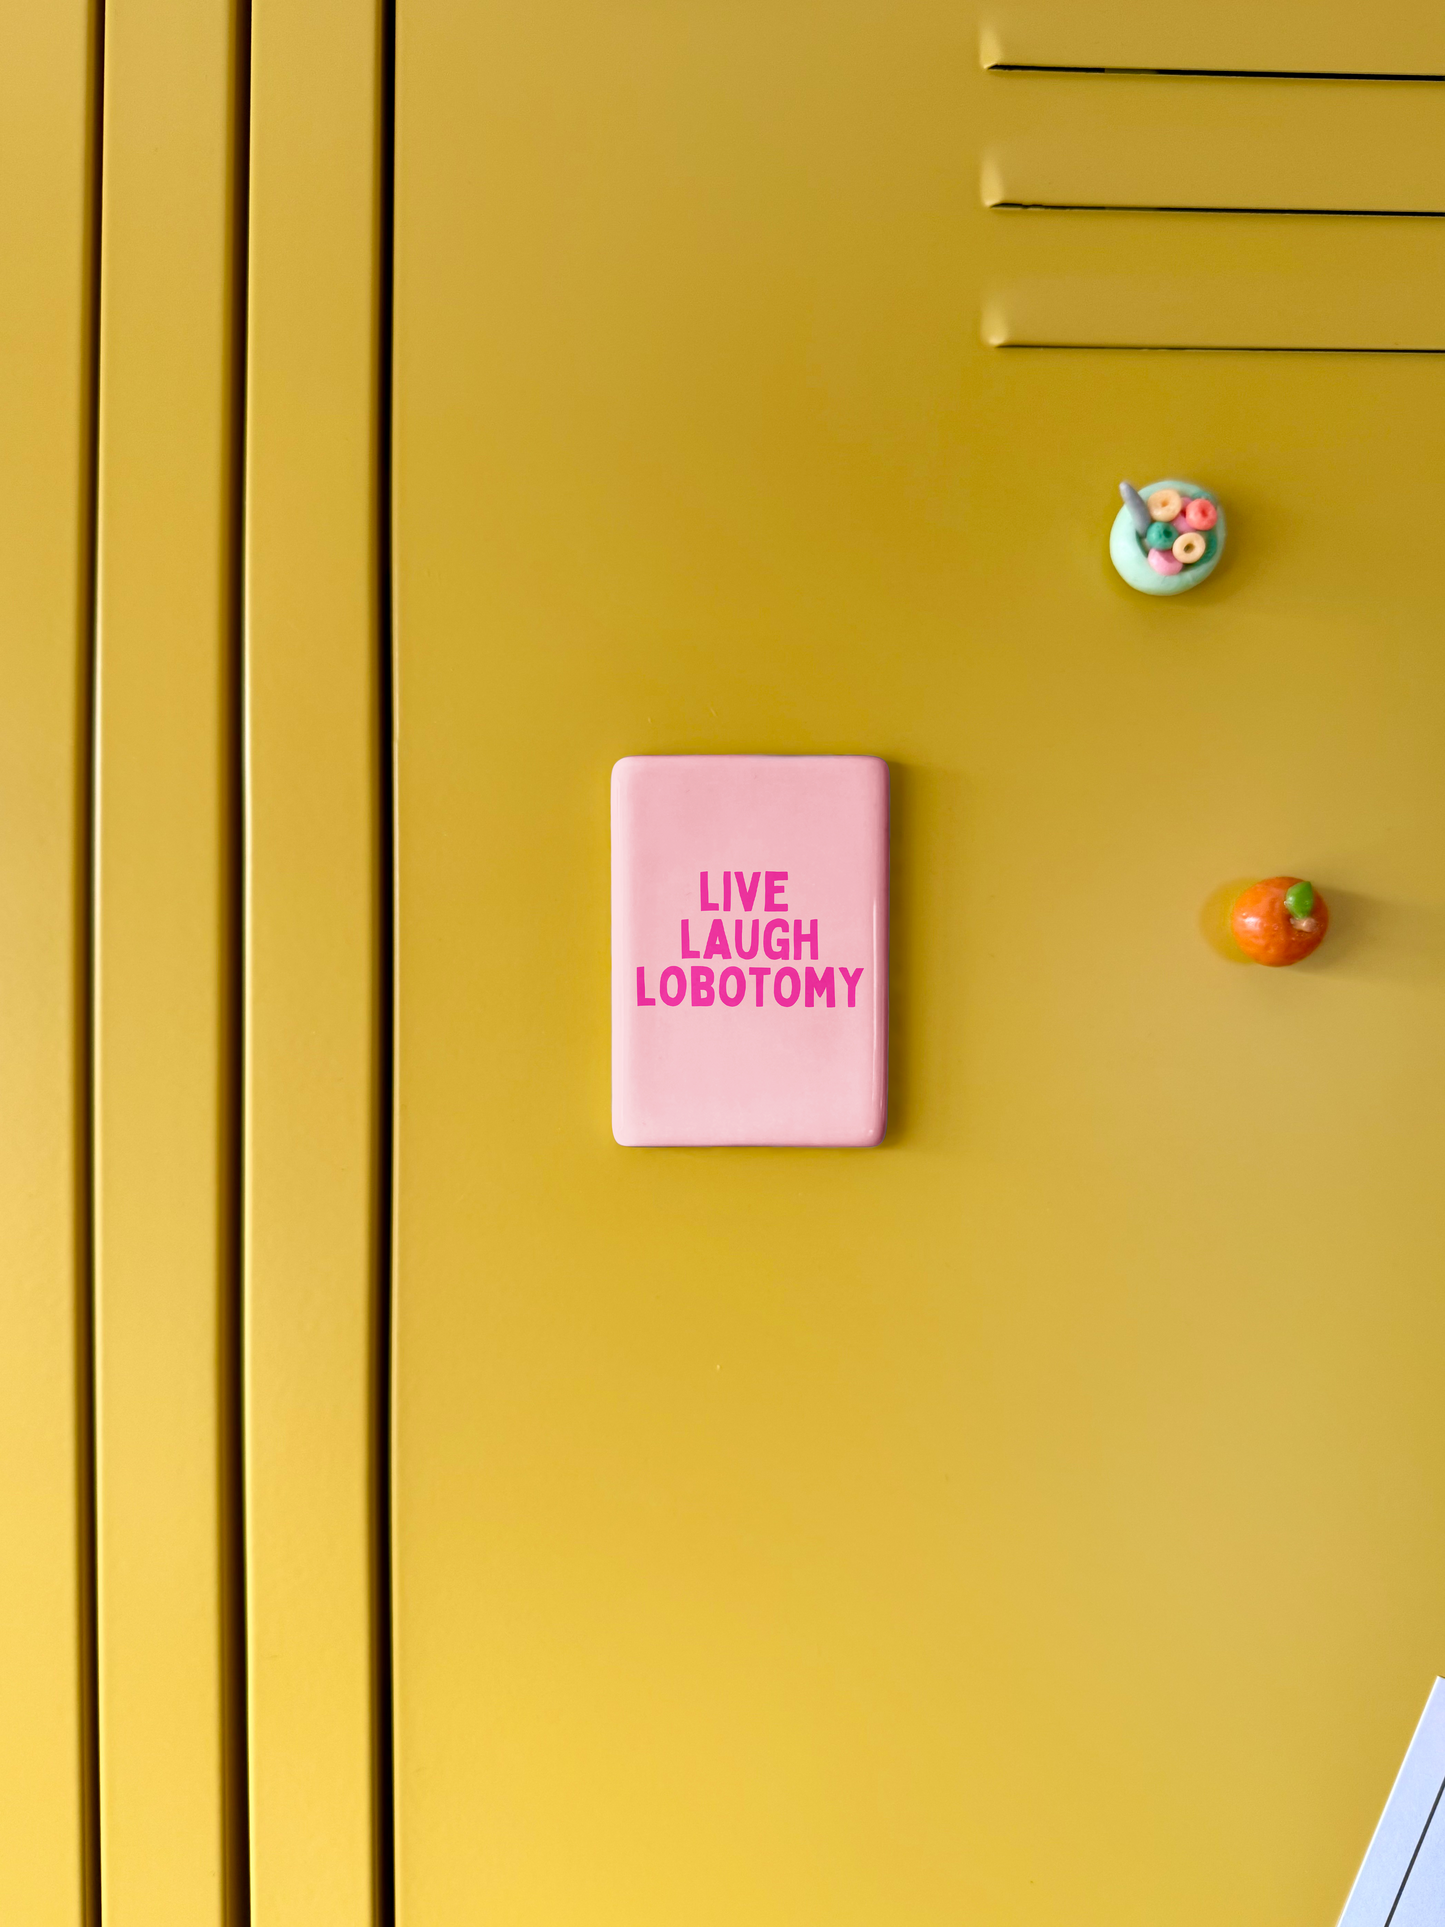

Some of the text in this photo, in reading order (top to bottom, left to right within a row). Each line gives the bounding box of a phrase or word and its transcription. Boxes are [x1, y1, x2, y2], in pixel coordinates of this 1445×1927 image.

[700, 871, 788, 912] LIVE
[681, 918, 818, 960] LAUGH
[636, 966, 864, 1008] LOBOTOMY
